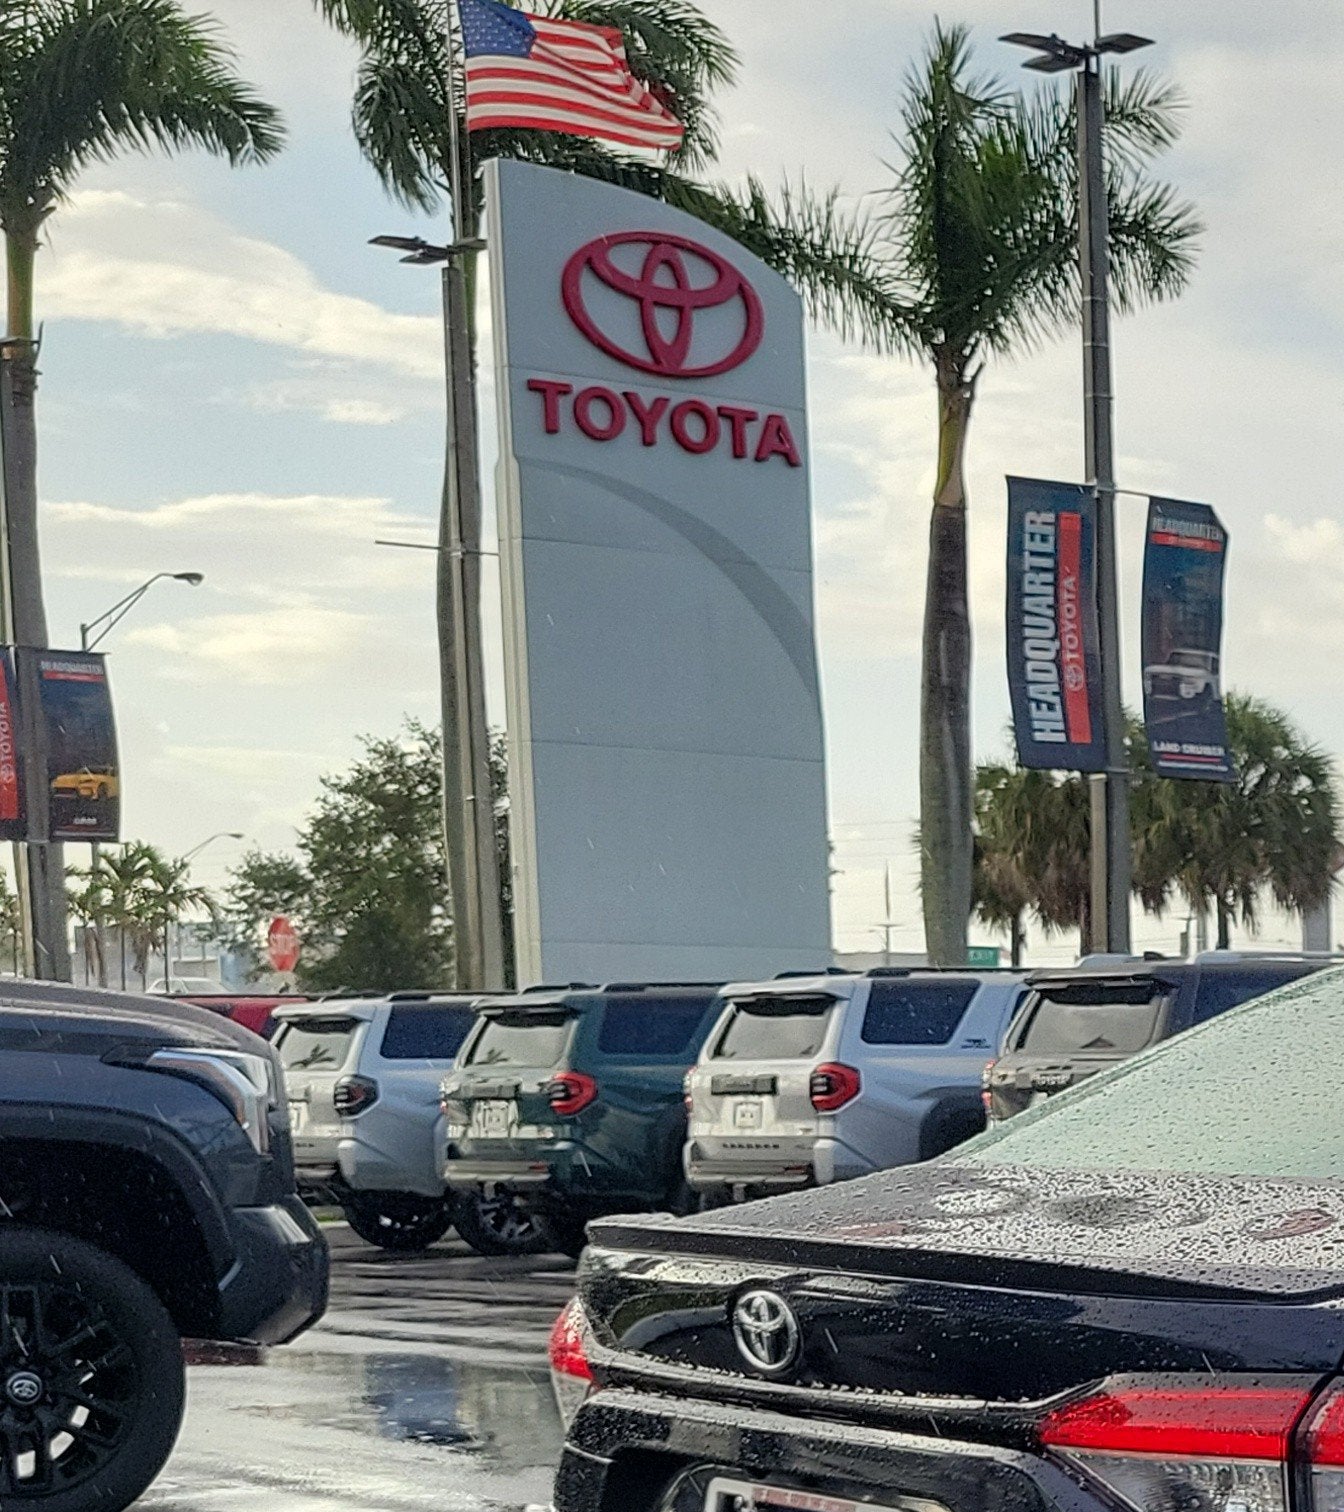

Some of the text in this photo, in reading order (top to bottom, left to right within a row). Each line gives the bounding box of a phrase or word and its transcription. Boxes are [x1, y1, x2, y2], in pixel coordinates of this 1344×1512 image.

[527, 378, 801, 468] TOYOTA
[1023, 510, 1067, 743] HEADQUARTER
[1059, 575, 1080, 661] TOYOTA
